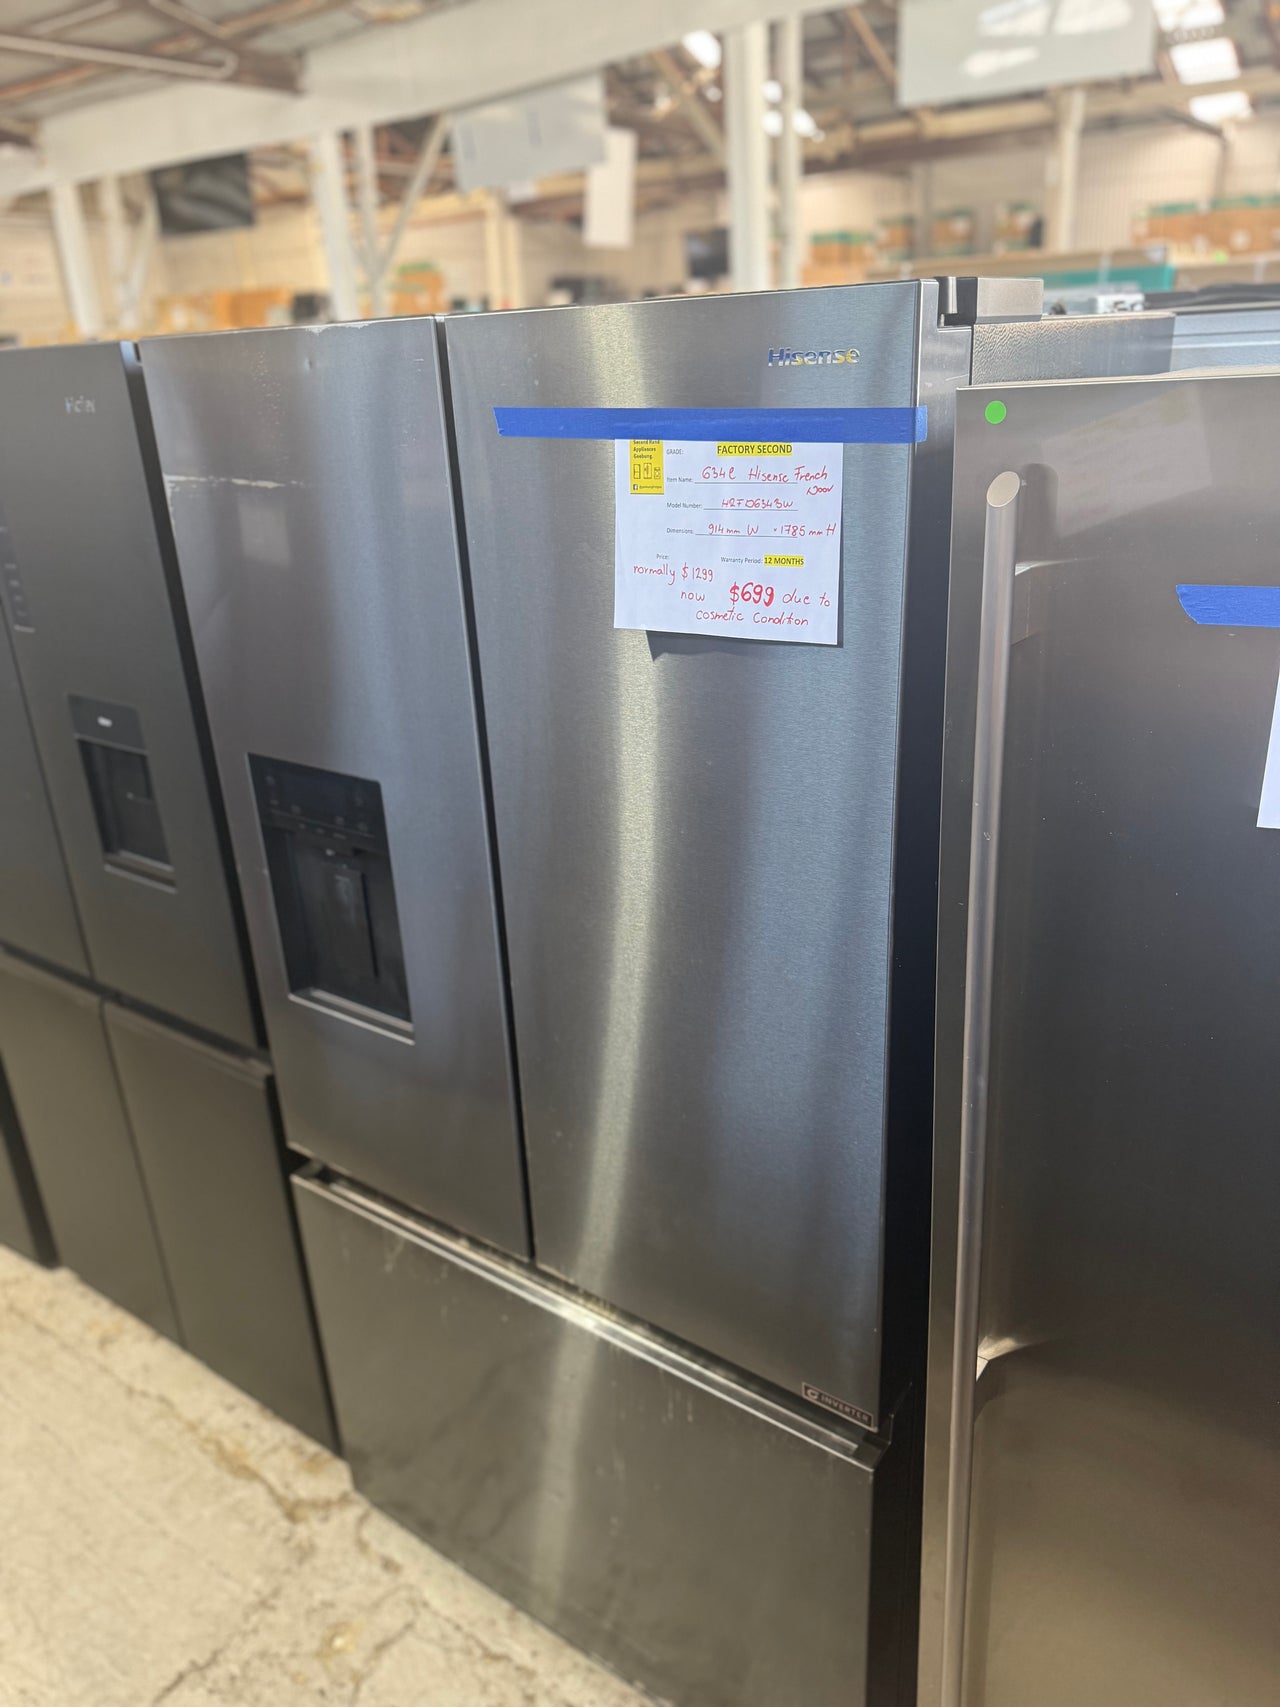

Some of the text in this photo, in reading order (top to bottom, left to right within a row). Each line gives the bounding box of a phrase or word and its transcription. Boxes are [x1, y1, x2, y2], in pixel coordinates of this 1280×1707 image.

[768, 347, 860, 367] Hisense
[717, 445, 755, 455] FACTORY
[757, 444, 793, 454] SECOND
[748, 465, 789, 483] Hisense
[794, 465, 828, 482] French
[747, 523, 759, 536] W
[720, 556, 744, 565] Warranty
[744, 557, 763, 565] Period:
[764, 556, 772, 565] 12
[773, 557, 804, 566] MONTHS
[633, 564, 676, 586] normally
[680, 582, 831, 607] now $699 due to
[753, 612, 809, 627] Condition
[820, 1393, 869, 1423] INVERTER
